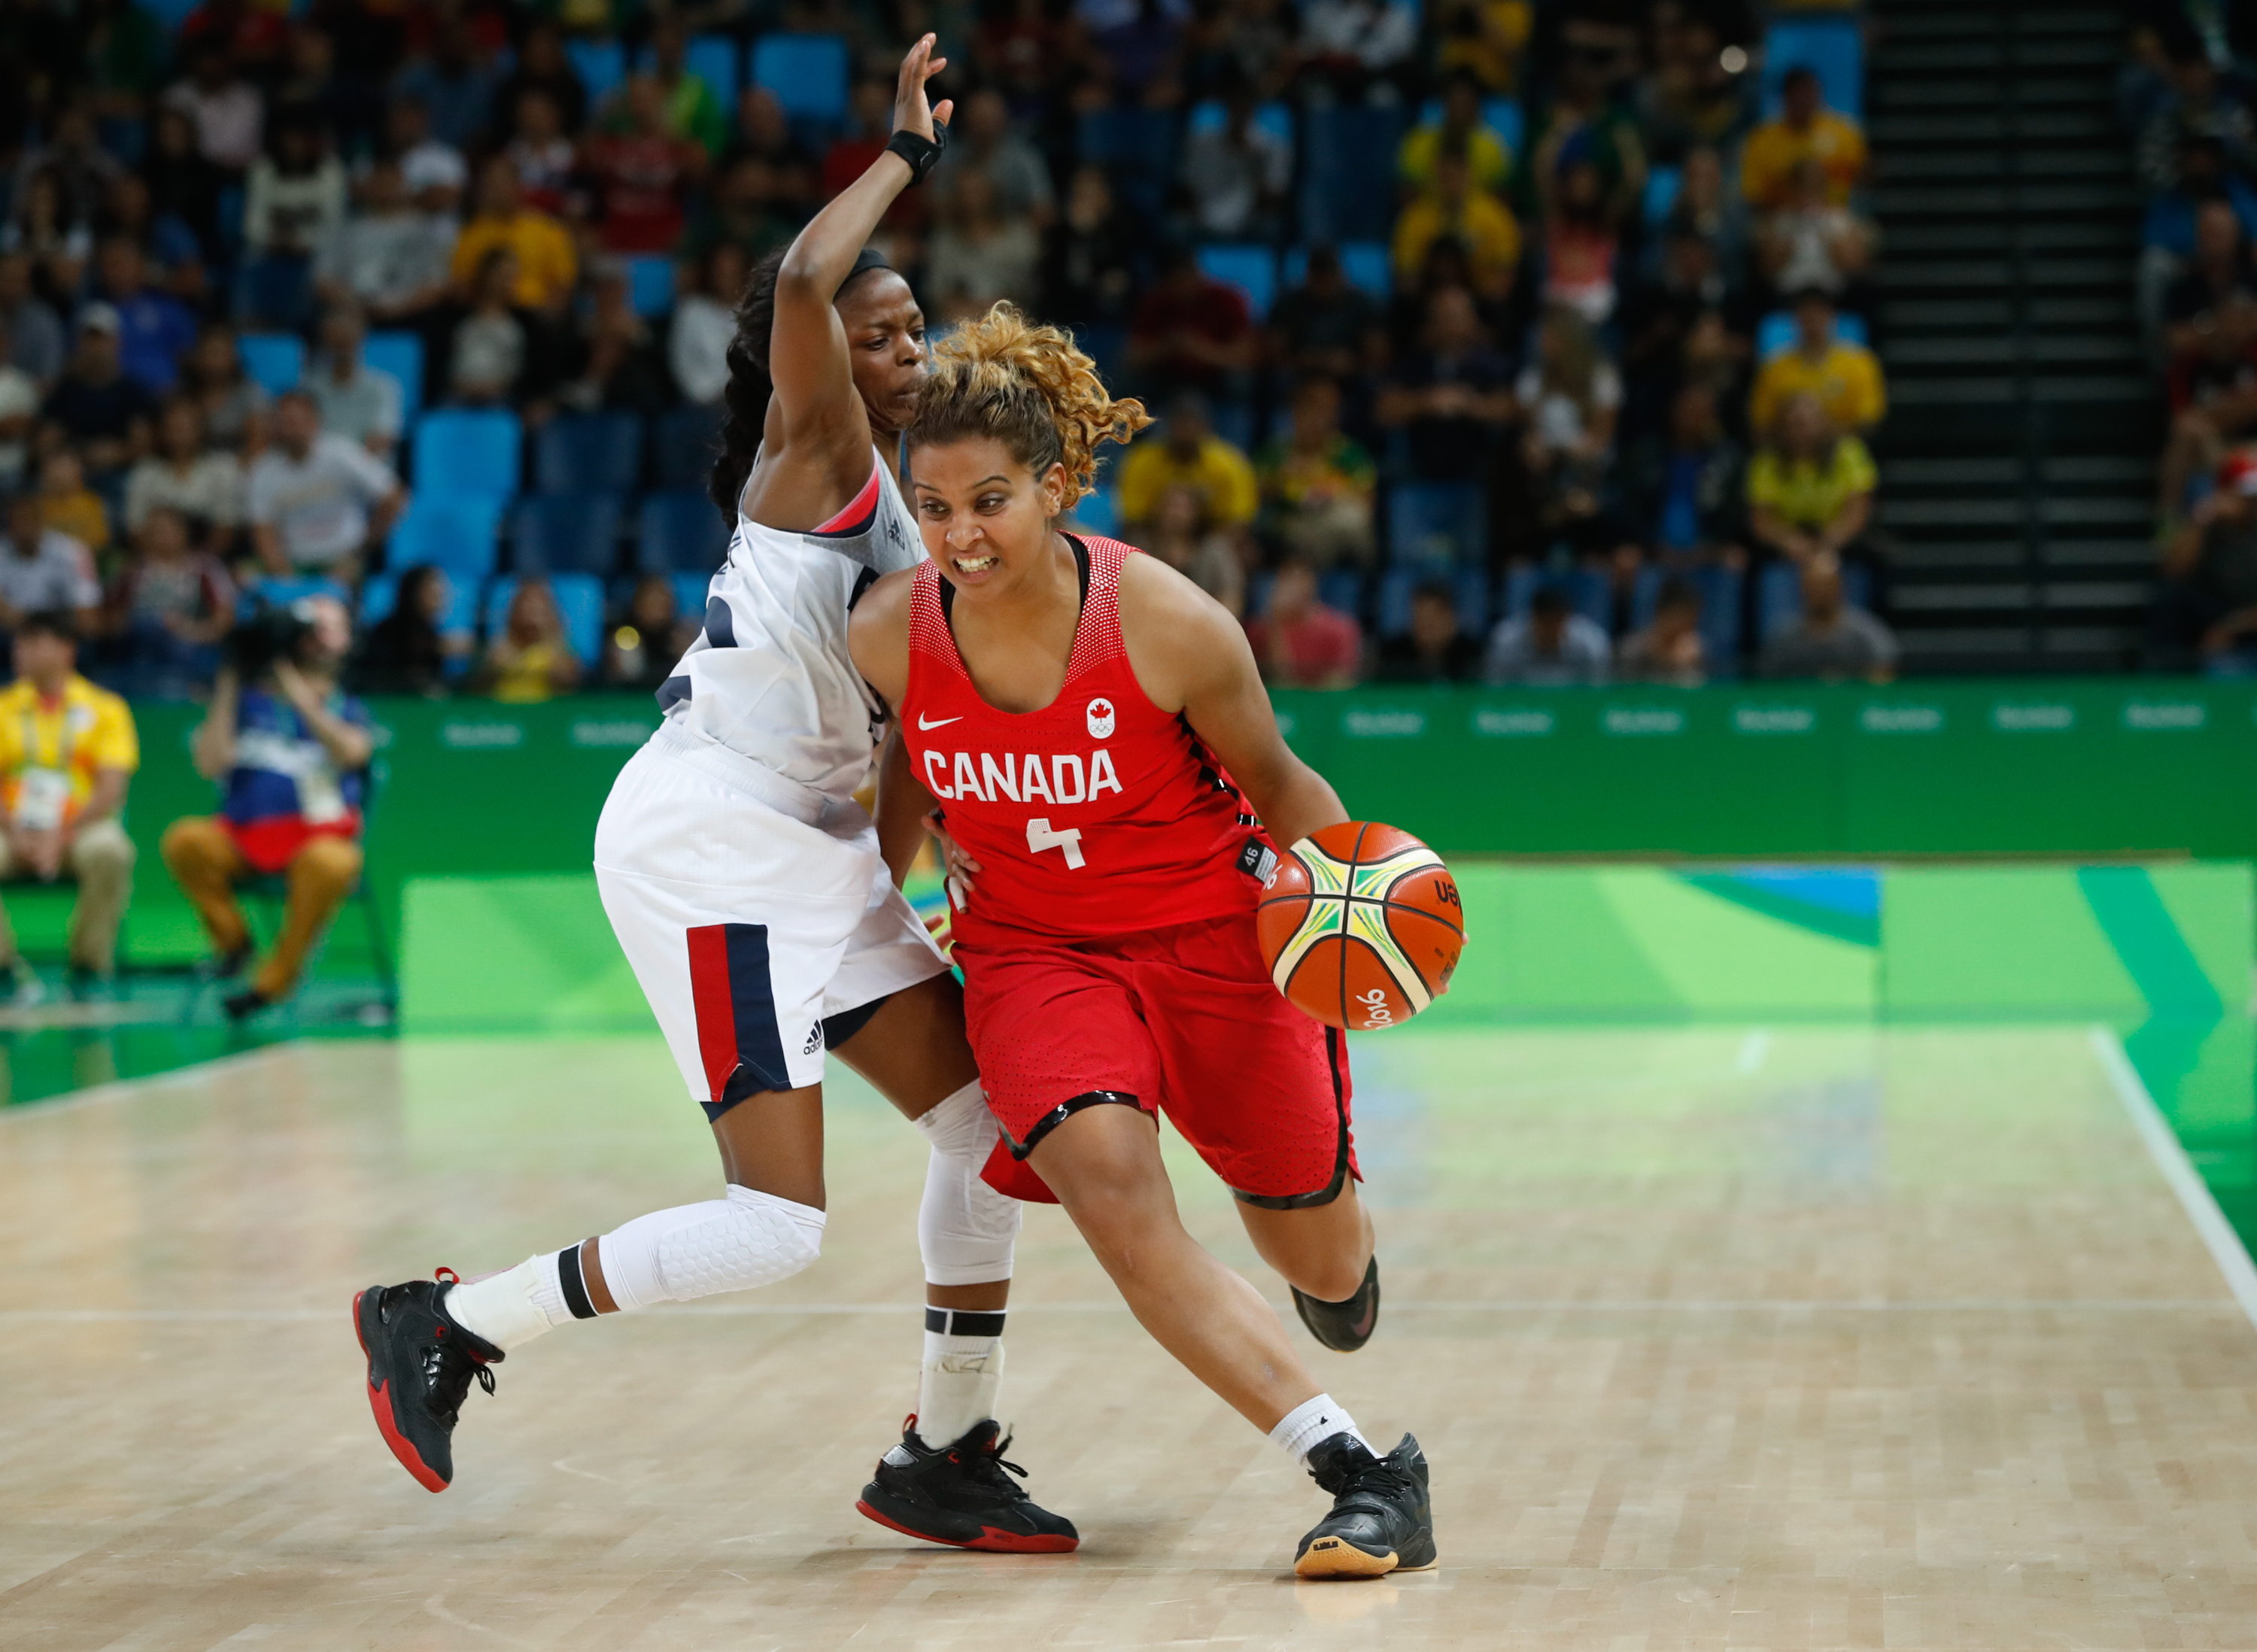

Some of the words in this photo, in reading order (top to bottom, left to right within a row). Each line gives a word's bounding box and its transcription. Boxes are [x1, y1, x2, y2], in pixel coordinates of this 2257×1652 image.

[923, 749, 1123, 804] CANADA
[1026, 818, 1086, 871] 4
[1244, 847, 1259, 867] 46
[1356, 988, 1393, 1028] 2016
